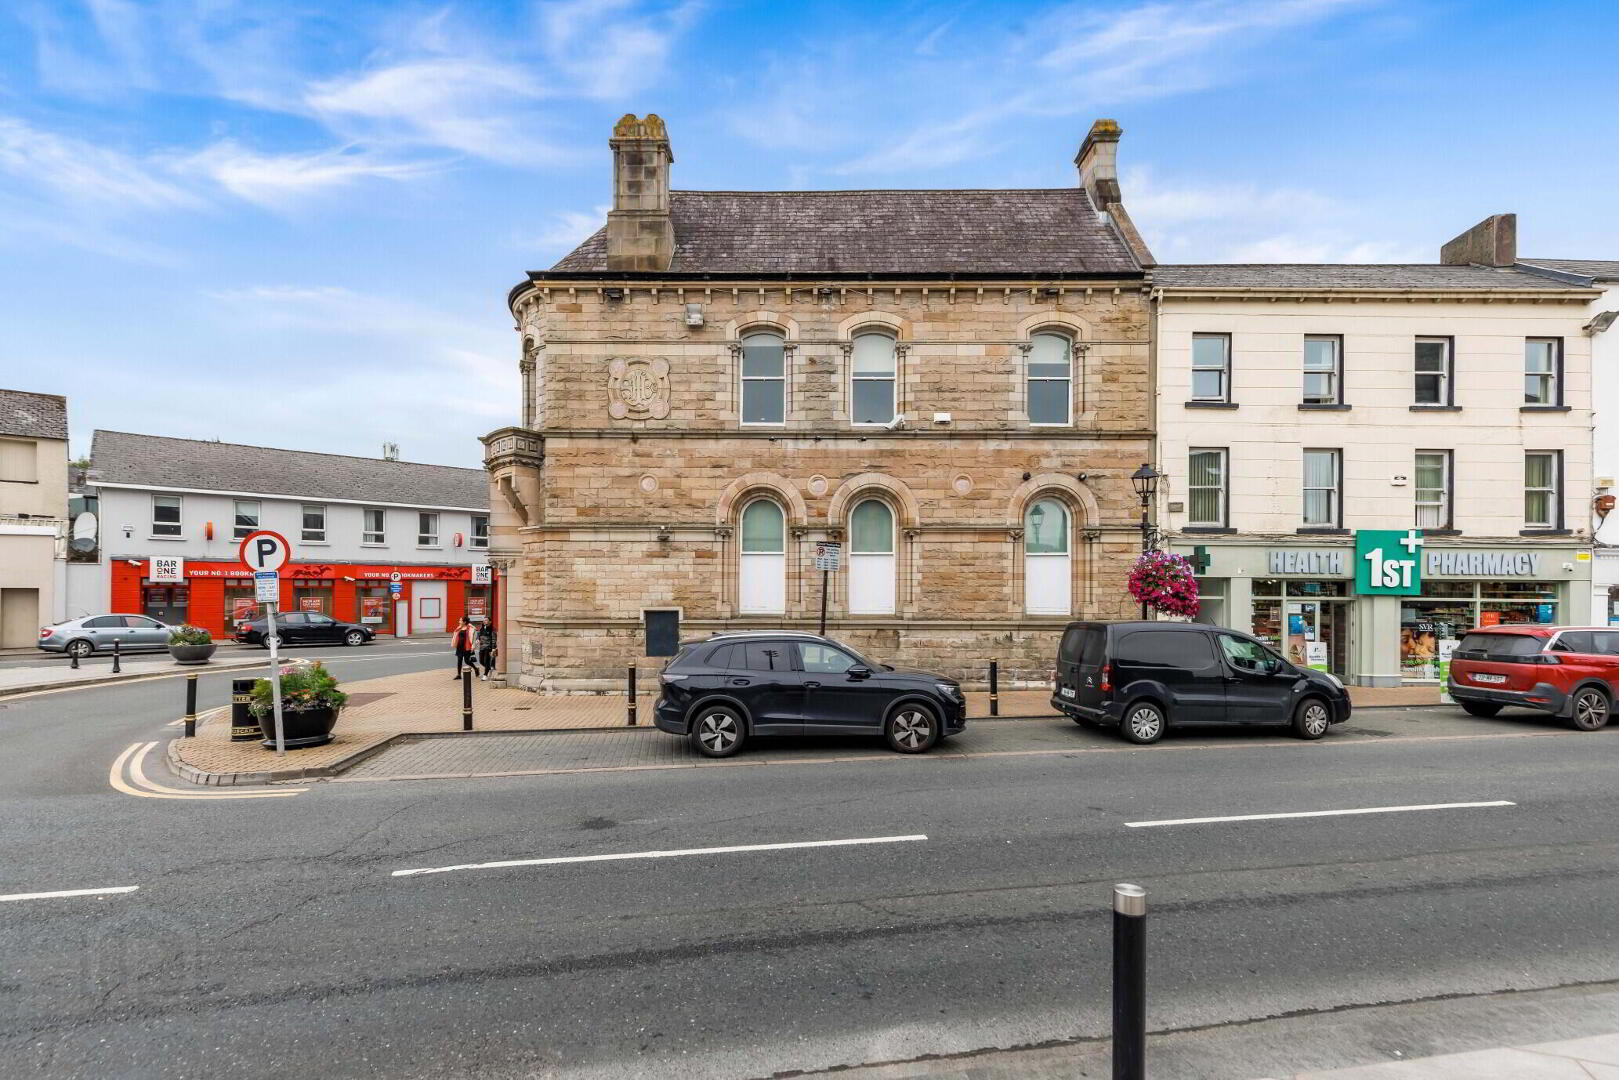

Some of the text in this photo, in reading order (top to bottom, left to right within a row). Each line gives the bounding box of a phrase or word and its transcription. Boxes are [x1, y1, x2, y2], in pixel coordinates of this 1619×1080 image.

[257, 539, 277, 567] P
[156, 567, 177, 575] ONE
[1269, 548, 1541, 587] HEALTH 1ST PHARMACY
